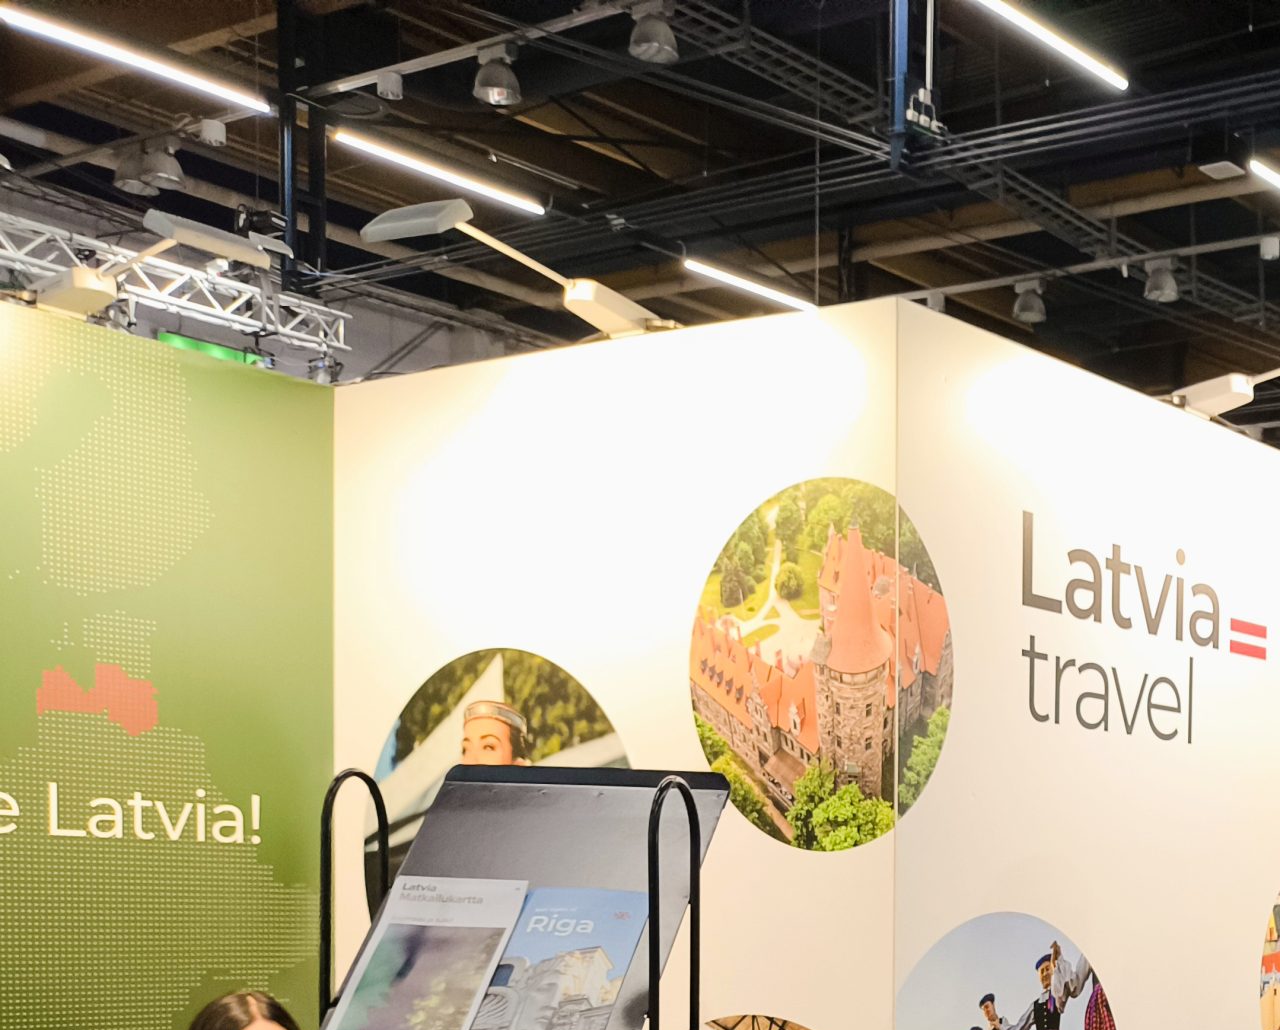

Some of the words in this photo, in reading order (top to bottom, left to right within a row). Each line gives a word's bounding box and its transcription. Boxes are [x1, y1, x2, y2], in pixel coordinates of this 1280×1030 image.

[1022, 510, 1220, 650] Latvia
[1021, 635, 1193, 744] travel
[48, 782, 262, 845] Latvia!
[402, 882, 437, 892] Latvia
